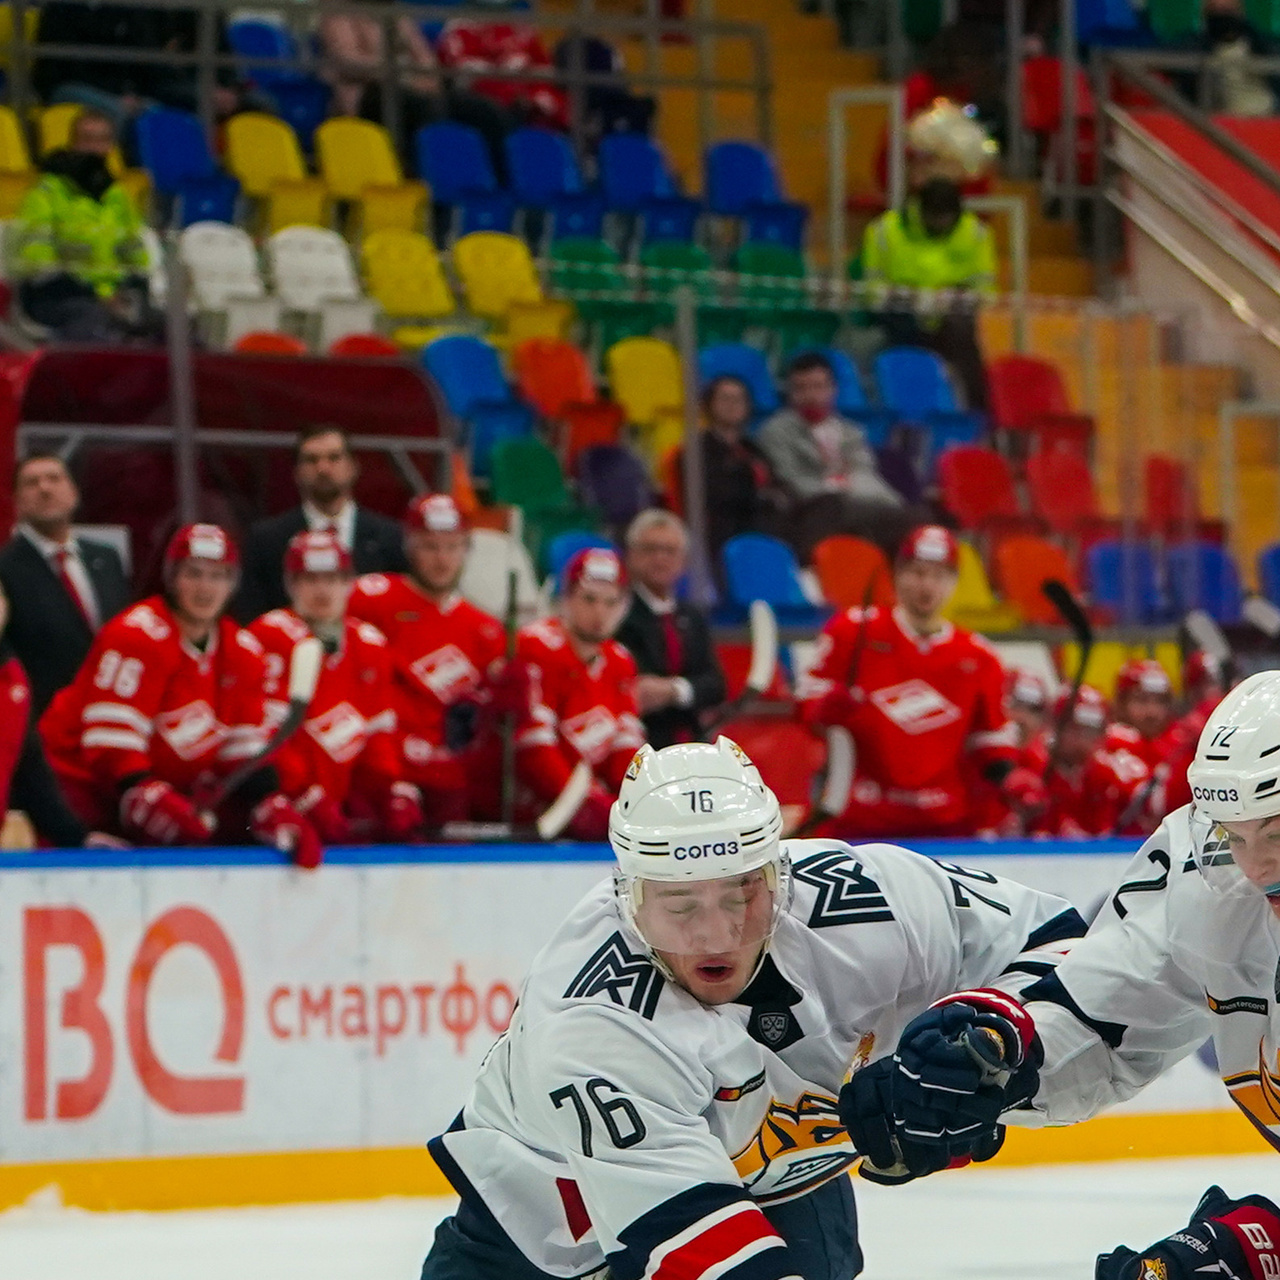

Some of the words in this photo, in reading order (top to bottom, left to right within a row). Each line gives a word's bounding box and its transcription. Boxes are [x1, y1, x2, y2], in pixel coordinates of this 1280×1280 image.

[1209, 725, 1238, 748] 72
[681, 789, 714, 813] 76
[1193, 786, 1239, 802] согаз
[673, 841, 740, 861] согаз
[22, 905, 246, 1122] BQ
[267, 961, 514, 1057] смартфо
[549, 1078, 647, 1157] 76
